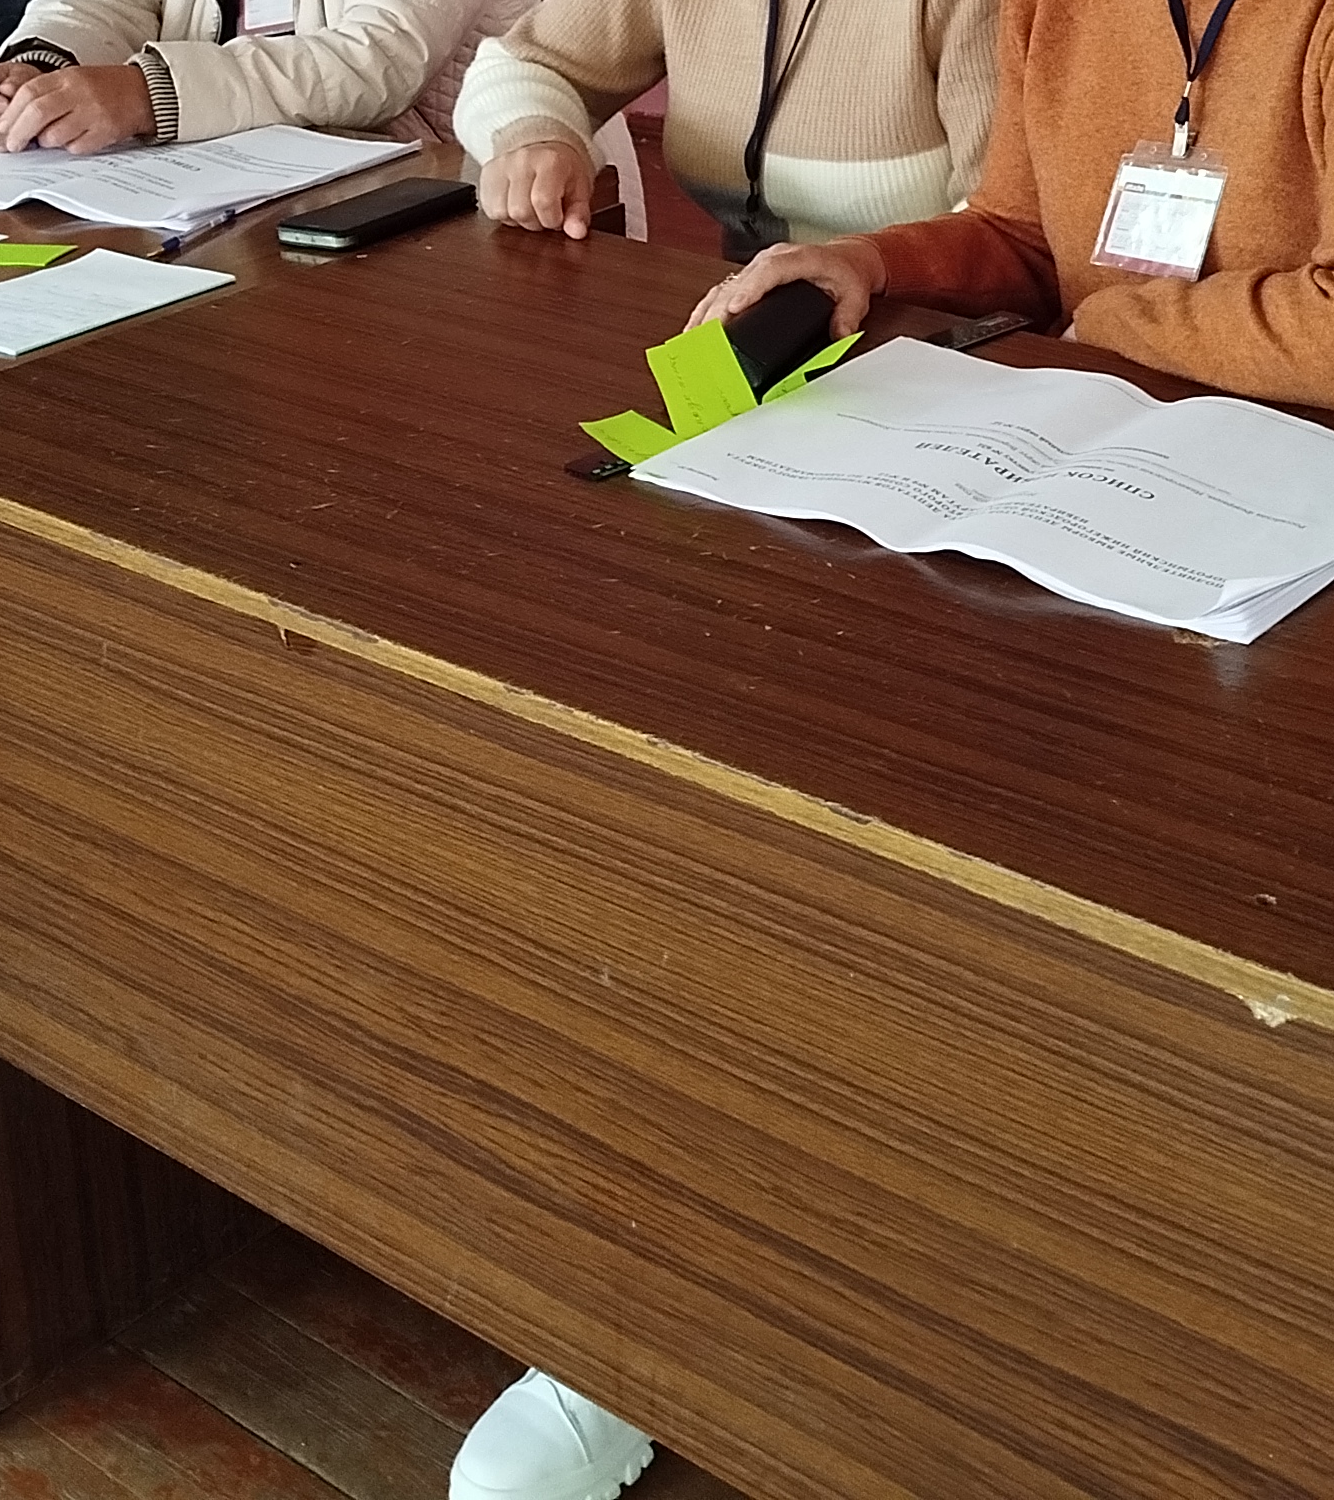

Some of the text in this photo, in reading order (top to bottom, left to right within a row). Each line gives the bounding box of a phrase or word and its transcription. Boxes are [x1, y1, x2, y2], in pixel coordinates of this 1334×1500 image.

[727, 453, 766, 470] ОКРУГА
[875, 483, 941, 513] ДЕПУТАТОВ
[1065, 471, 1155, 500] СПИСОК
[1021, 507, 1131, 550] НИЖЕГОРОДСКОЙ
[1061, 525, 1114, 551] ВЫБОРЫ
